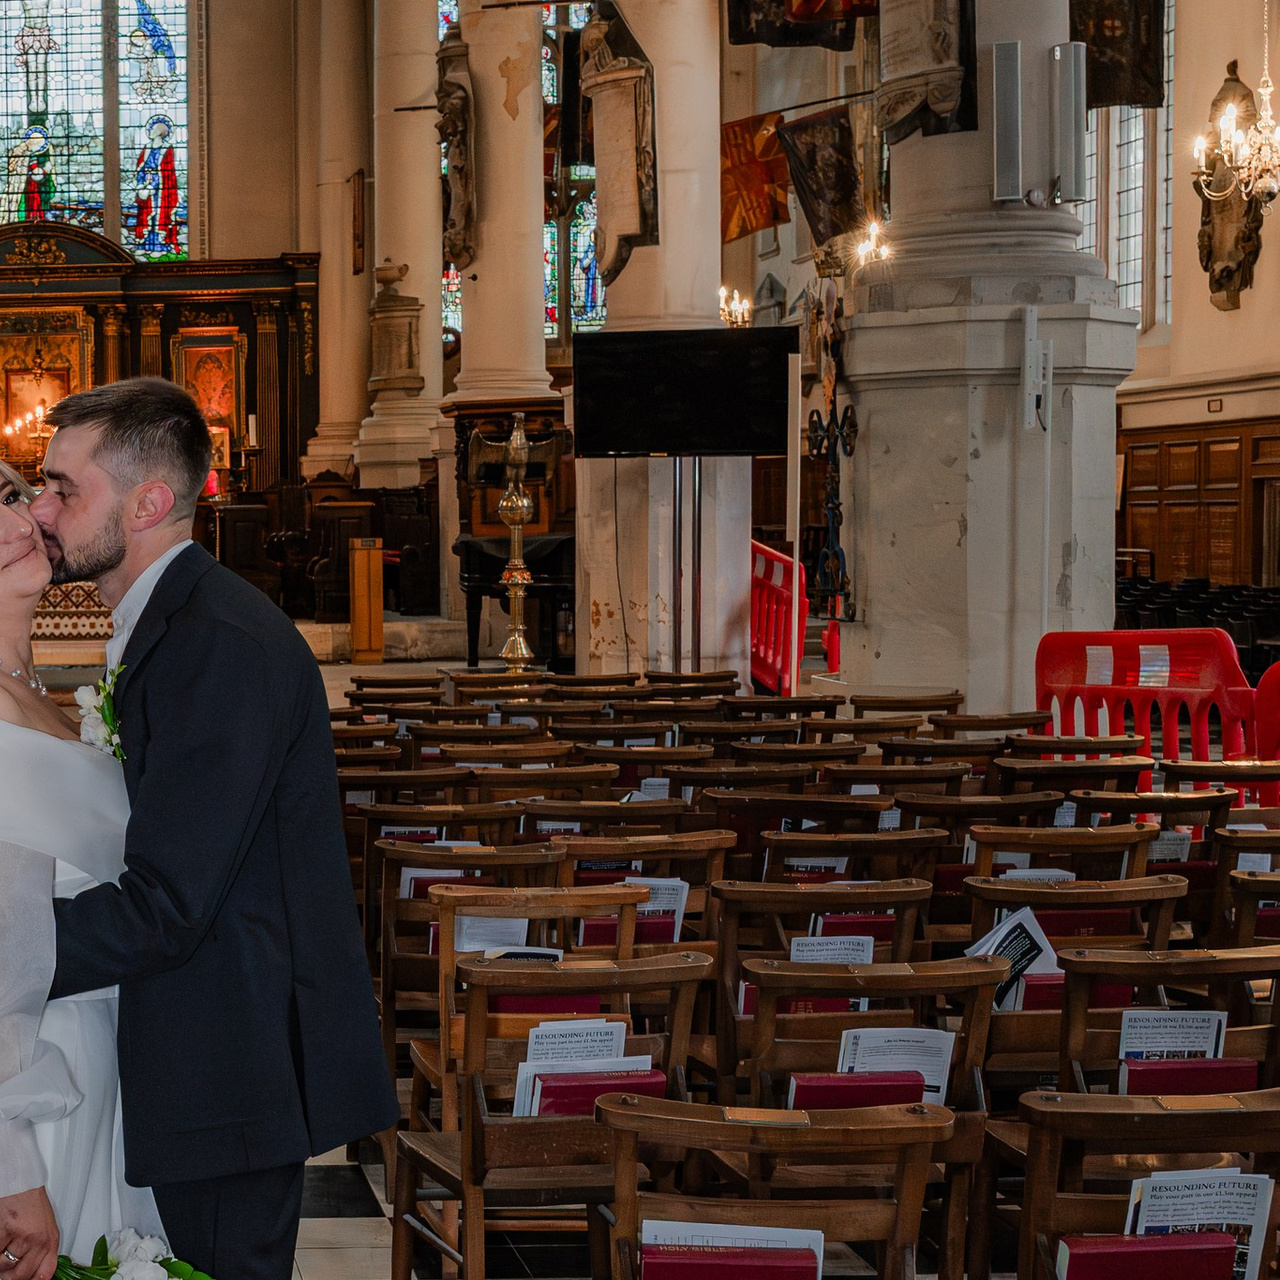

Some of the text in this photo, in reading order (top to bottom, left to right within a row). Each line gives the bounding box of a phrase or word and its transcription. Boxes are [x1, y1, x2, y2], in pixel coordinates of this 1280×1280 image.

[535, 1031, 584, 1040] RESOUNDING
[1151, 1181, 1259, 1193] RESOUNDING FUTURE
[1235, 1191, 1259, 1199] appeal
